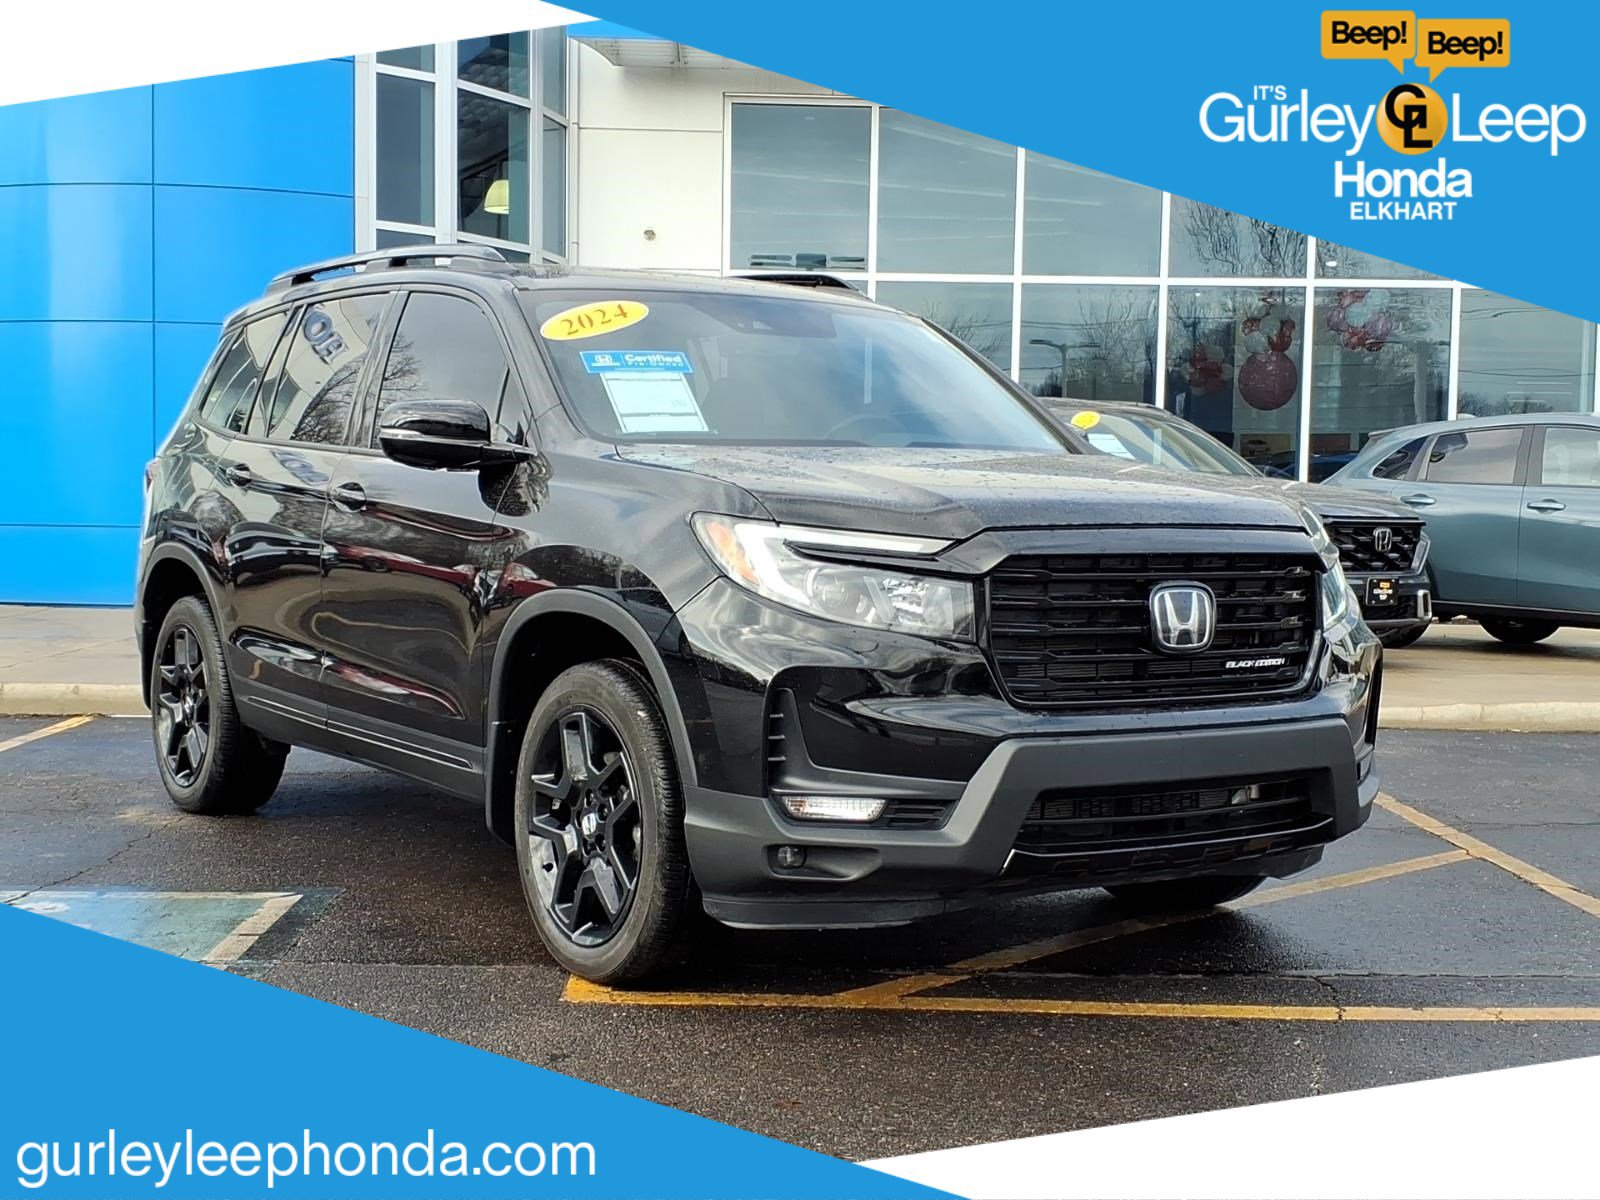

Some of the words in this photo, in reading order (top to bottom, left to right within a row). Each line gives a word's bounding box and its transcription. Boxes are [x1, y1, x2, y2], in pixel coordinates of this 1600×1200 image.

[560, 303, 629, 336] 2024
[624, 353, 682, 364] Certified
[1225, 660, 1254, 669] BLACK
